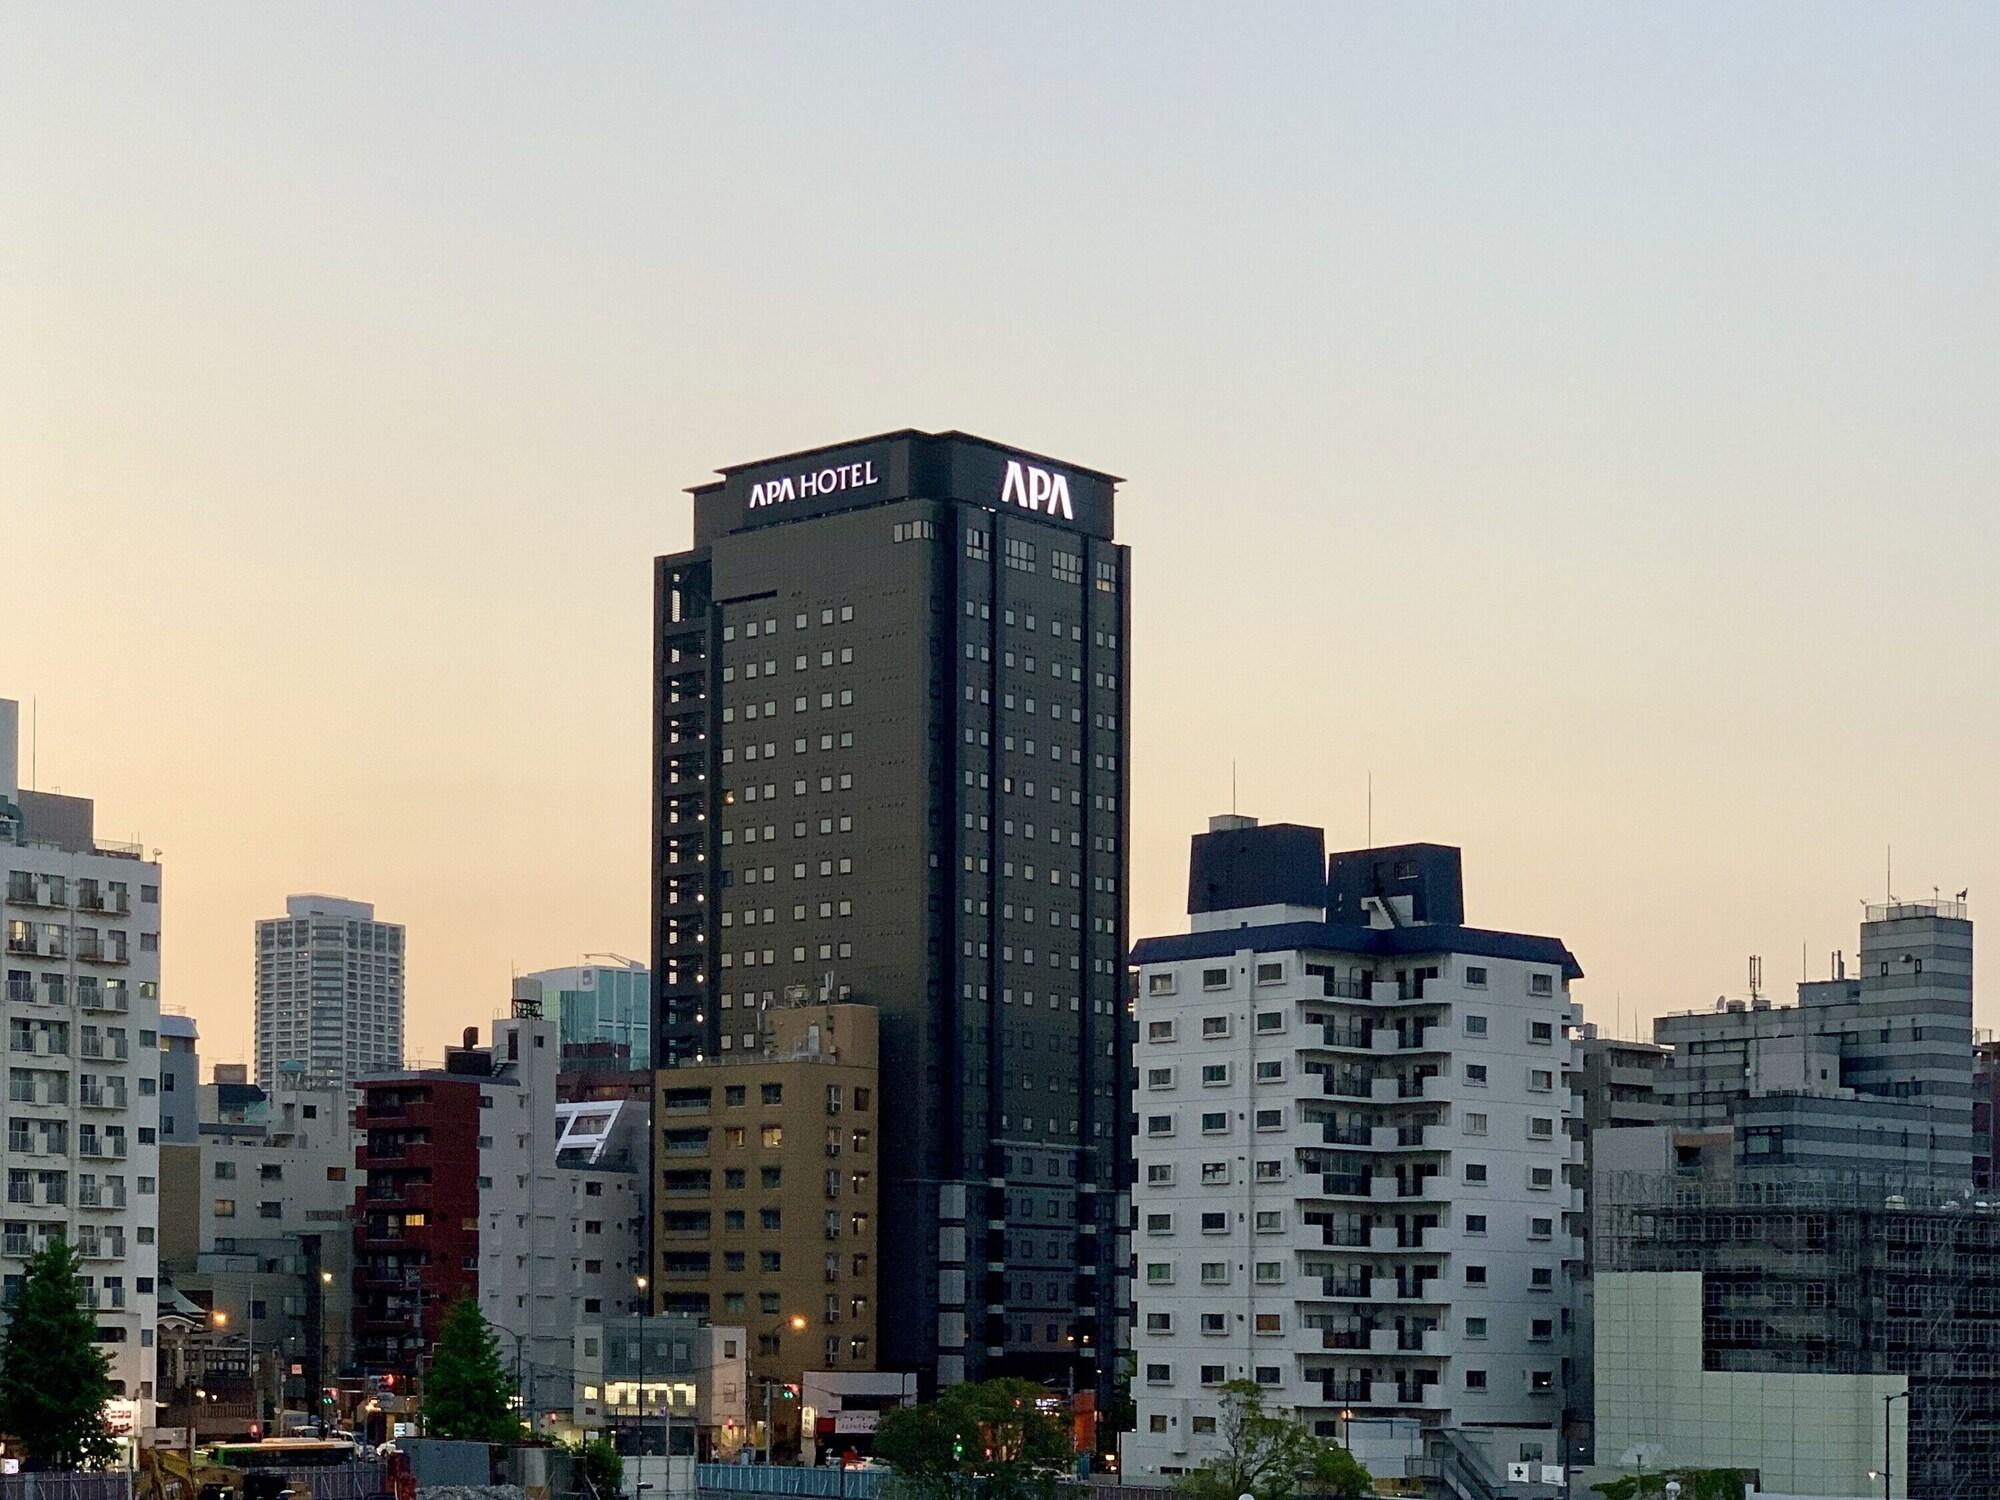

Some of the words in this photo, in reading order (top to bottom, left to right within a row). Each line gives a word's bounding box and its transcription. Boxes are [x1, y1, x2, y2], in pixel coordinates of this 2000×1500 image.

[750, 478, 795, 508] APA
[801, 461, 878, 498] HOTEL
[1002, 460, 1073, 520] APA
